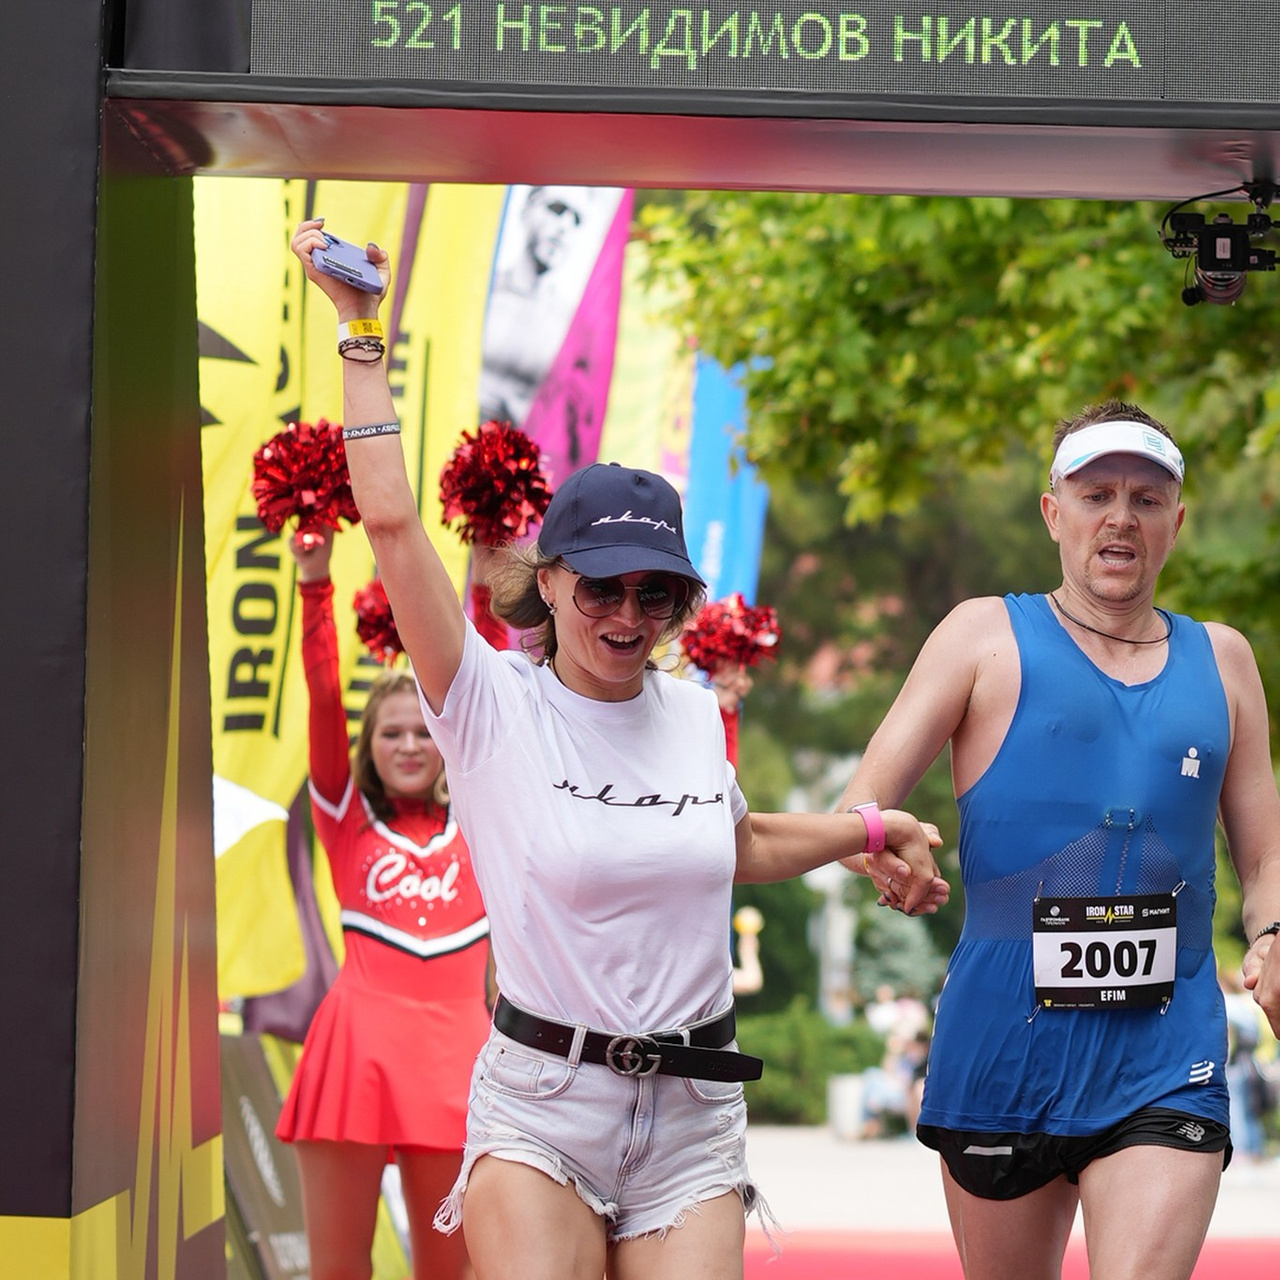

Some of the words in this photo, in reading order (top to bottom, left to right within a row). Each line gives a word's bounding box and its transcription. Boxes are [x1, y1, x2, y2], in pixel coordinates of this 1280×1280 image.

[371, 1, 463, 51] 521
[496, 4, 871, 71] НЕВИДИМОВ
[893, 14, 1142, 68] НИКИТА
[366, 852, 460, 903] Cool
[1086, 906, 1106, 917] IRON
[1114, 905, 1135, 915] STAR
[1060, 939, 1157, 979] 2007
[1100, 989, 1126, 1002] EFIM
